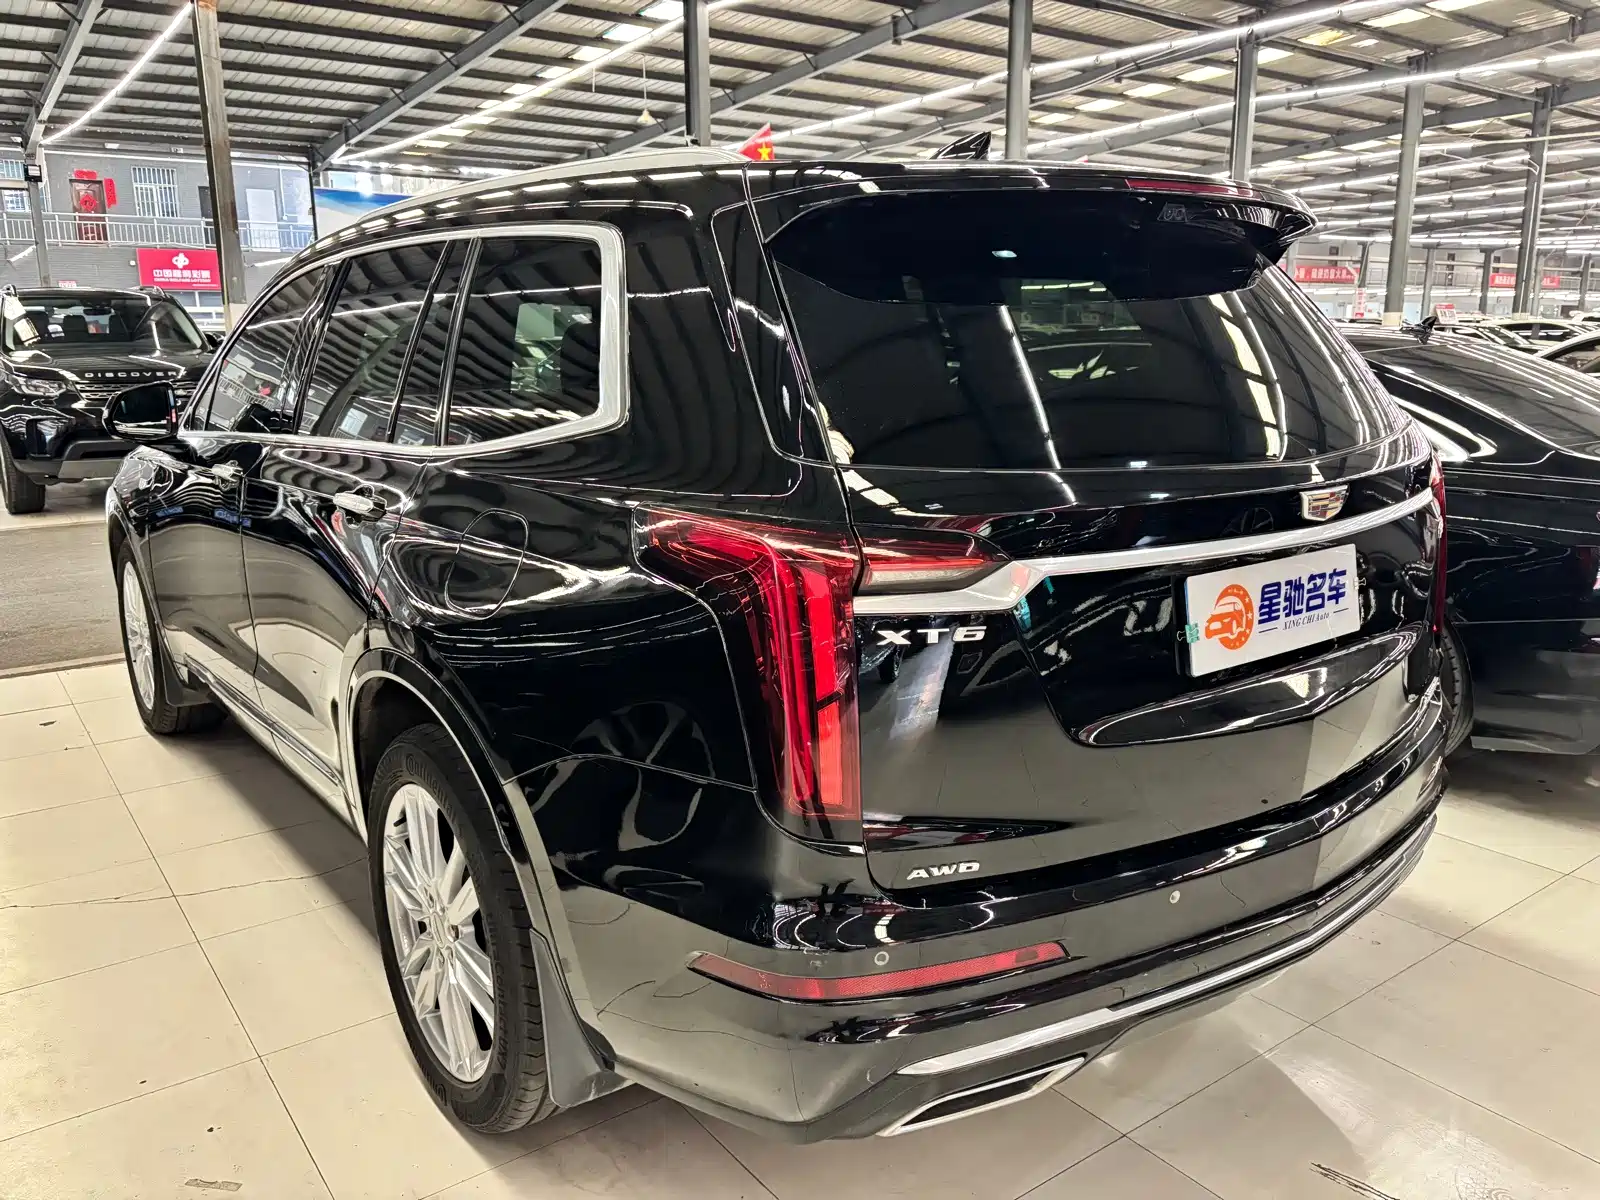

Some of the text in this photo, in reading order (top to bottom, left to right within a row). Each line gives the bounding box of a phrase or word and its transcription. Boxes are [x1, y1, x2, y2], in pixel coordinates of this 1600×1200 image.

[1258, 568, 1347, 625] 星驰名车
[1283, 611, 1330, 630] XING CHI Auto
[876, 625, 987, 646] XT6
[906, 861, 981, 881] AWD
